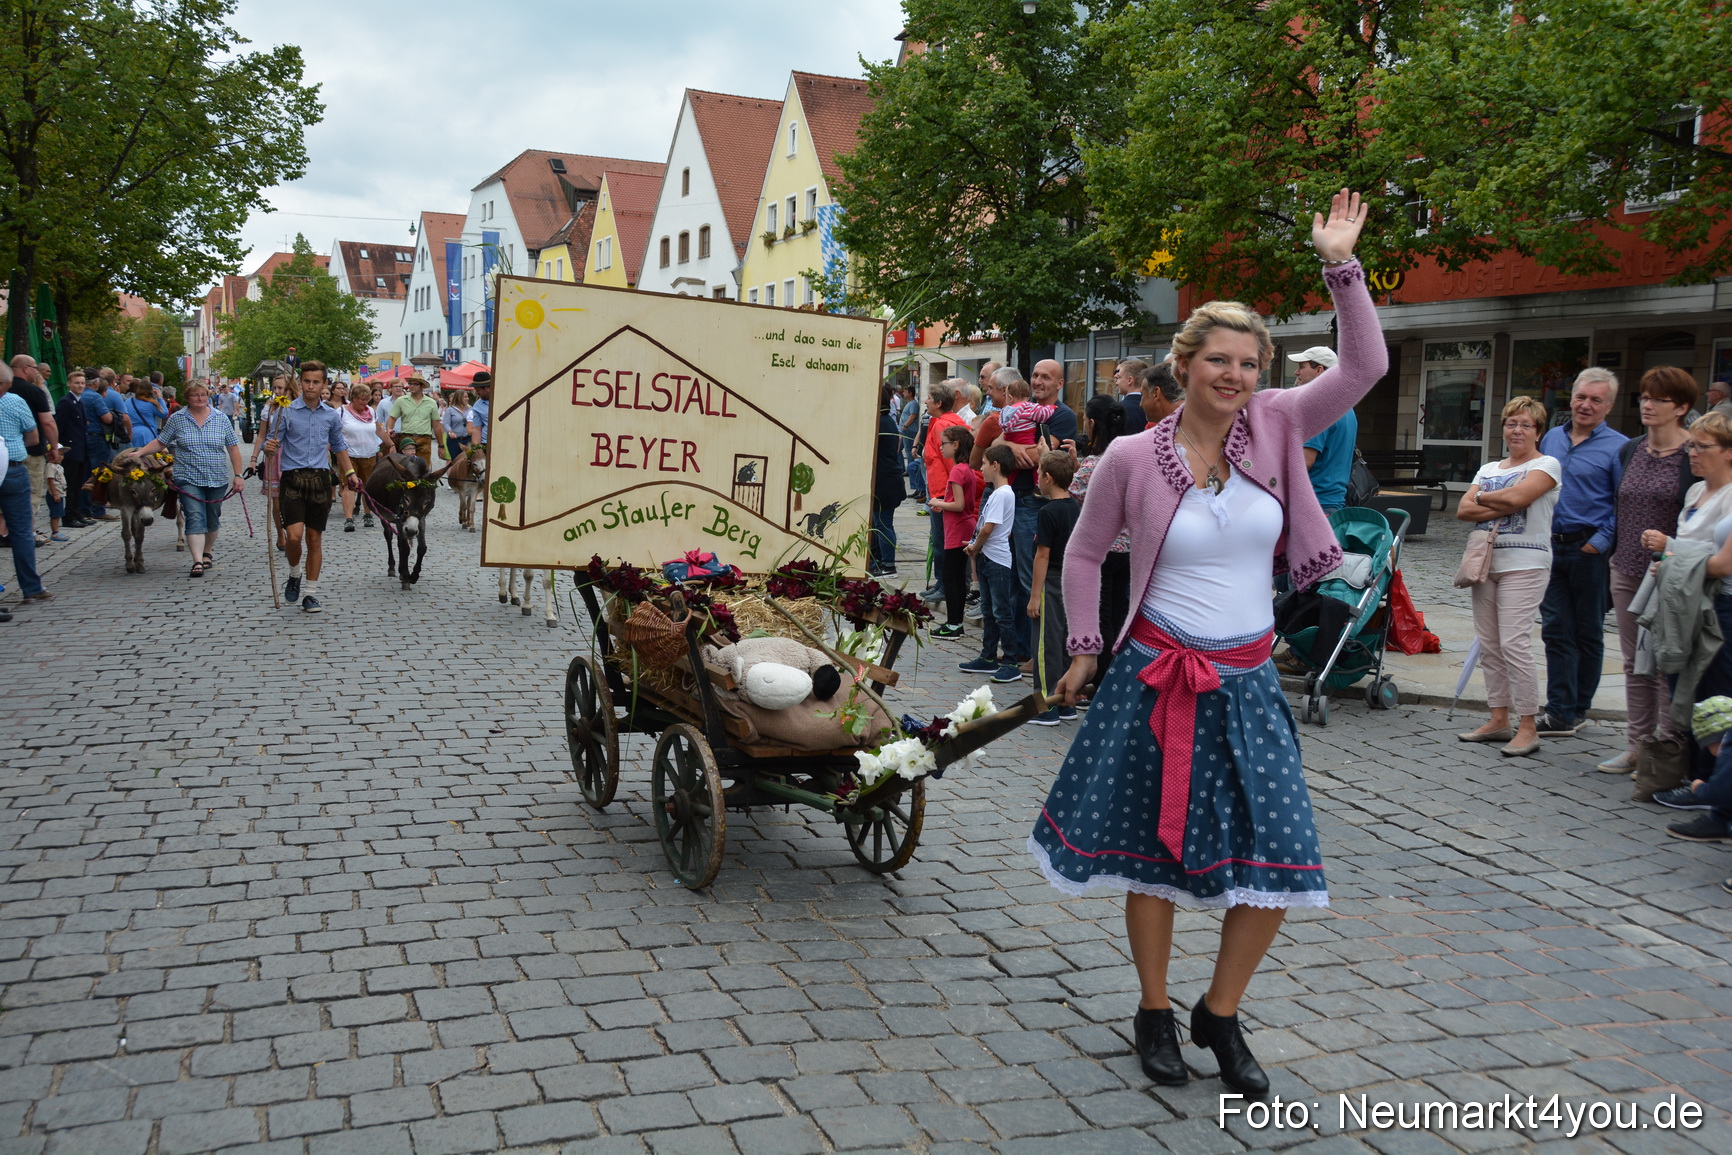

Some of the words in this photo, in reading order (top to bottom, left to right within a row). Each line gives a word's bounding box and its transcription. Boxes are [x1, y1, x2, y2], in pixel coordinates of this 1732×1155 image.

[794, 330, 815, 344] dao
[822, 338, 841, 348] san
[846, 337, 862, 349] die
[771, 353, 796, 368] Esel
[805, 358, 849, 373] dahoam
[572, 369, 737, 418] ESELSTALL
[590, 433, 701, 473] BEYER
[563, 519, 597, 542] am
[601, 491, 696, 529] Staufer
[702, 504, 763, 559] Berg
